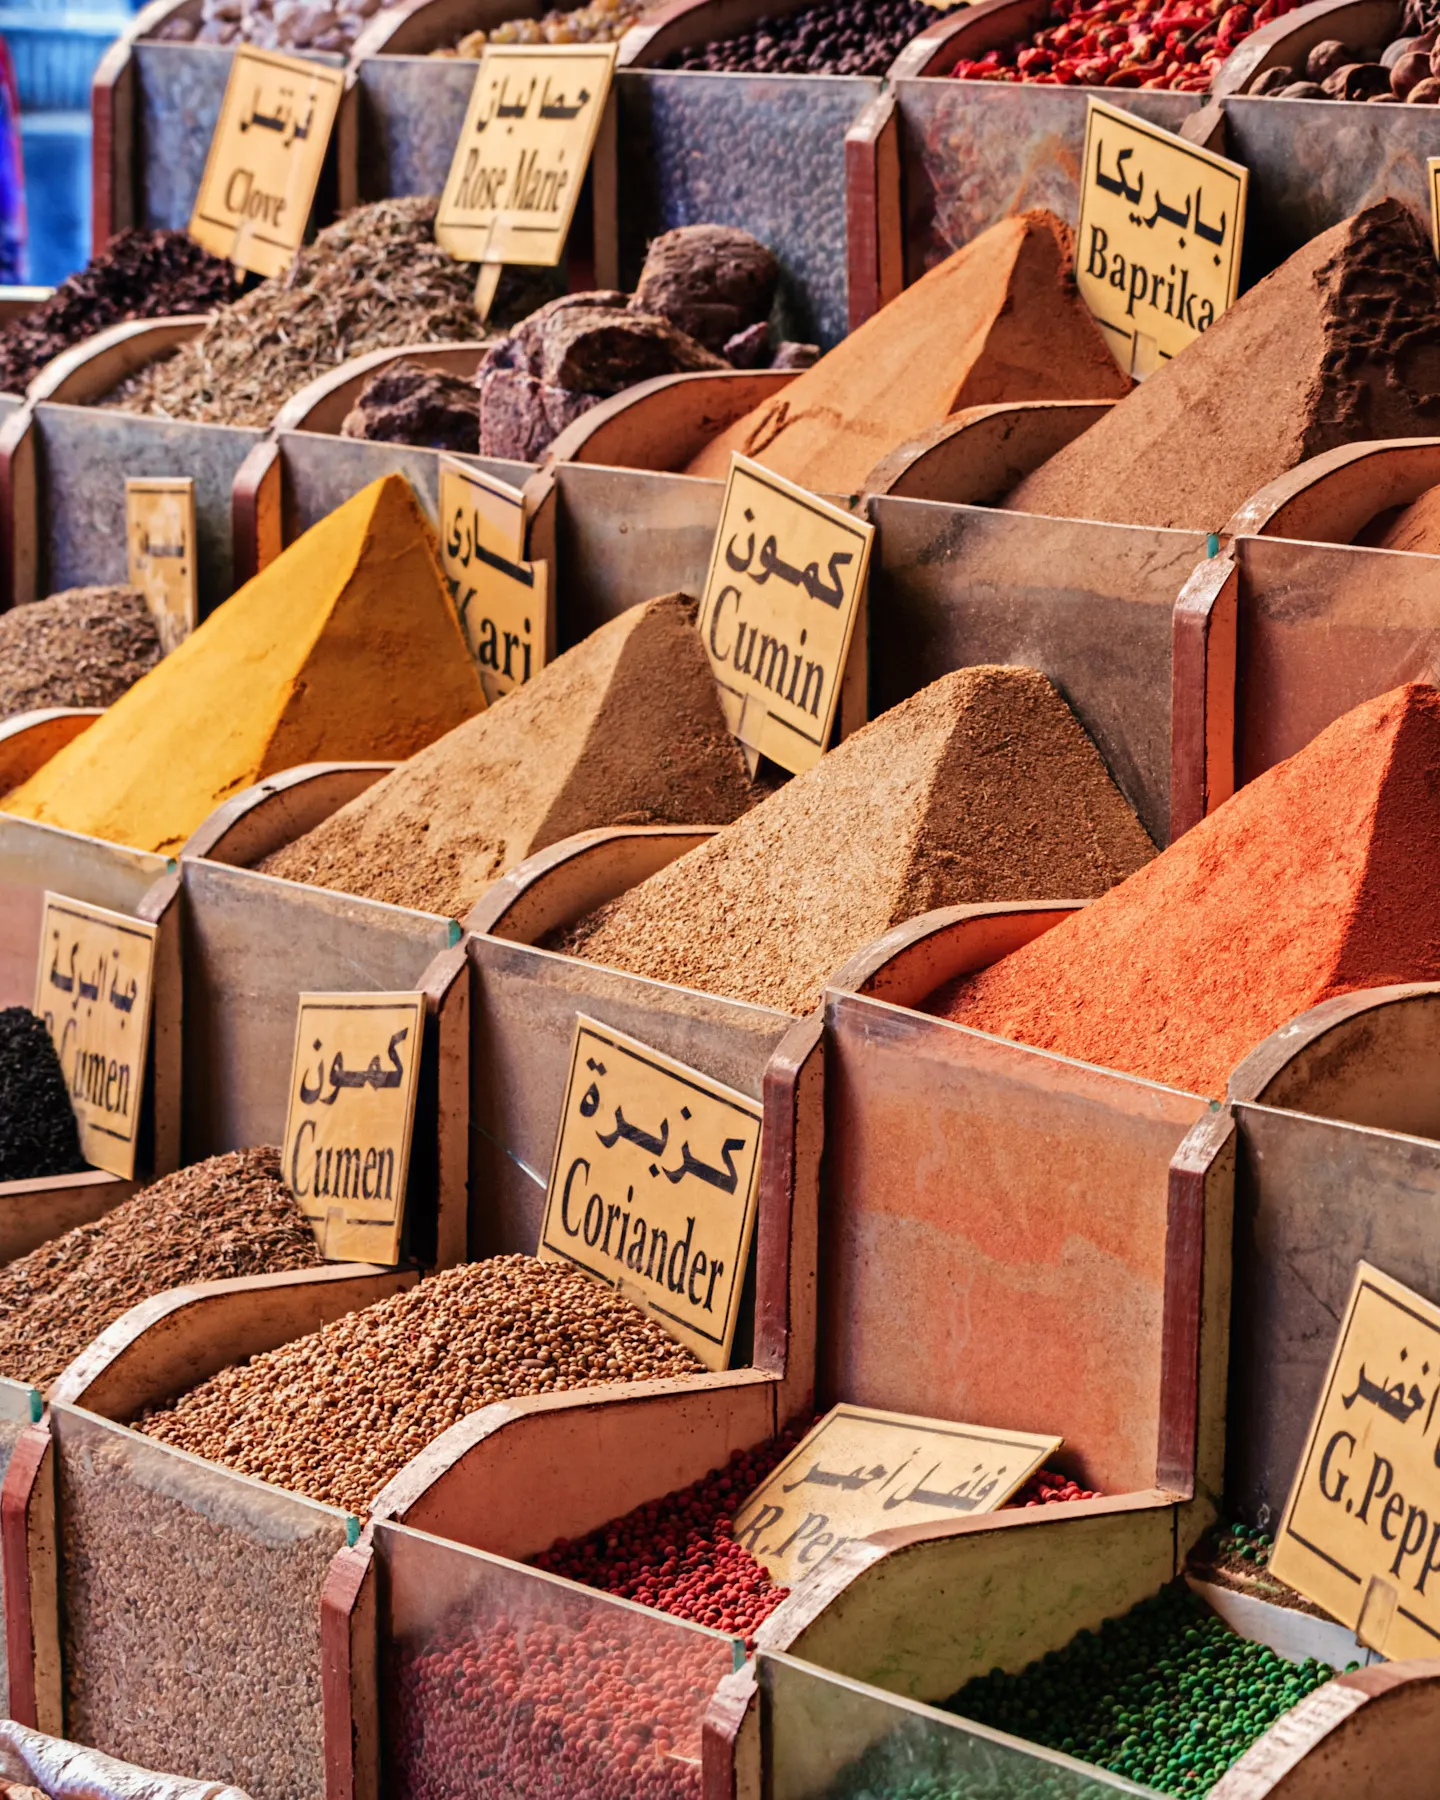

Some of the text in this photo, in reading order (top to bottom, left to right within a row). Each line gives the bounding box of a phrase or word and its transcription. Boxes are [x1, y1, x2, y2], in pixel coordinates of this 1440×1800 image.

[224, 167, 287, 228] Clove
[453, 147, 570, 214] Rose Marie
[1095, 138, 1227, 267] بابريكا
[1085, 223, 1216, 333] Baprika
[725, 507, 854, 610] كمون
[709, 585, 826, 720] Cumin
[300, 1027, 409, 1106] كمون
[291, 1119, 395, 1201] Cumen
[578, 1056, 747, 1196] كزبرة
[561, 1157, 725, 1314] Coriander
[882, 1460, 1008, 1511] فلفل
